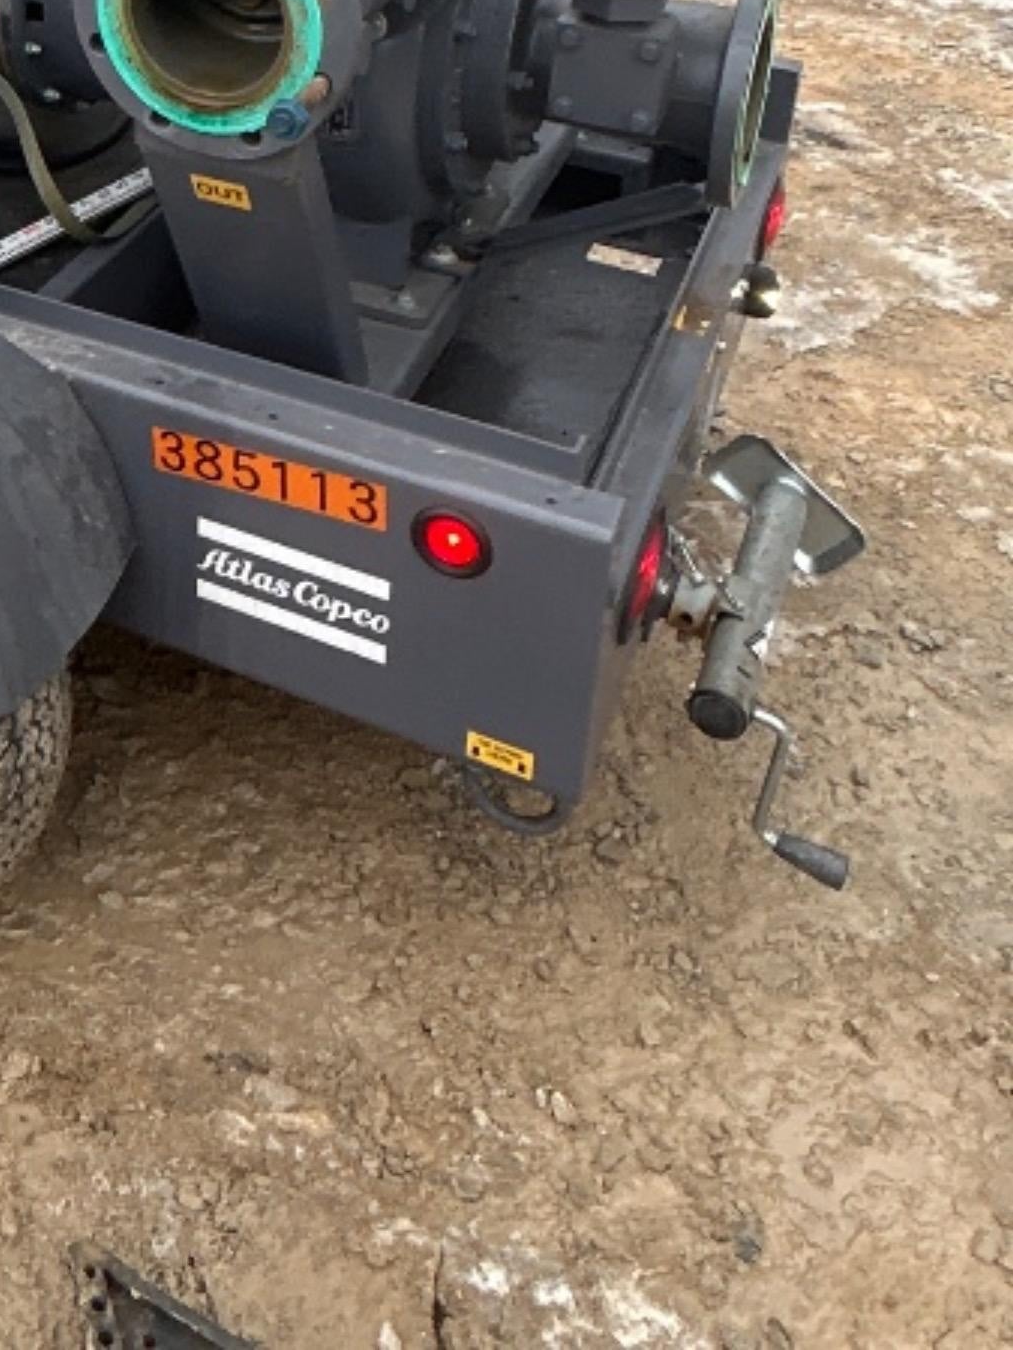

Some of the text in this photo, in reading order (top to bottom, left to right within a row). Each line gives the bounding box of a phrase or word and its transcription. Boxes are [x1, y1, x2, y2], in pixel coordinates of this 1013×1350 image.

[159, 430, 379, 525] 385113
[196, 548, 391, 634] Atlas Copco
